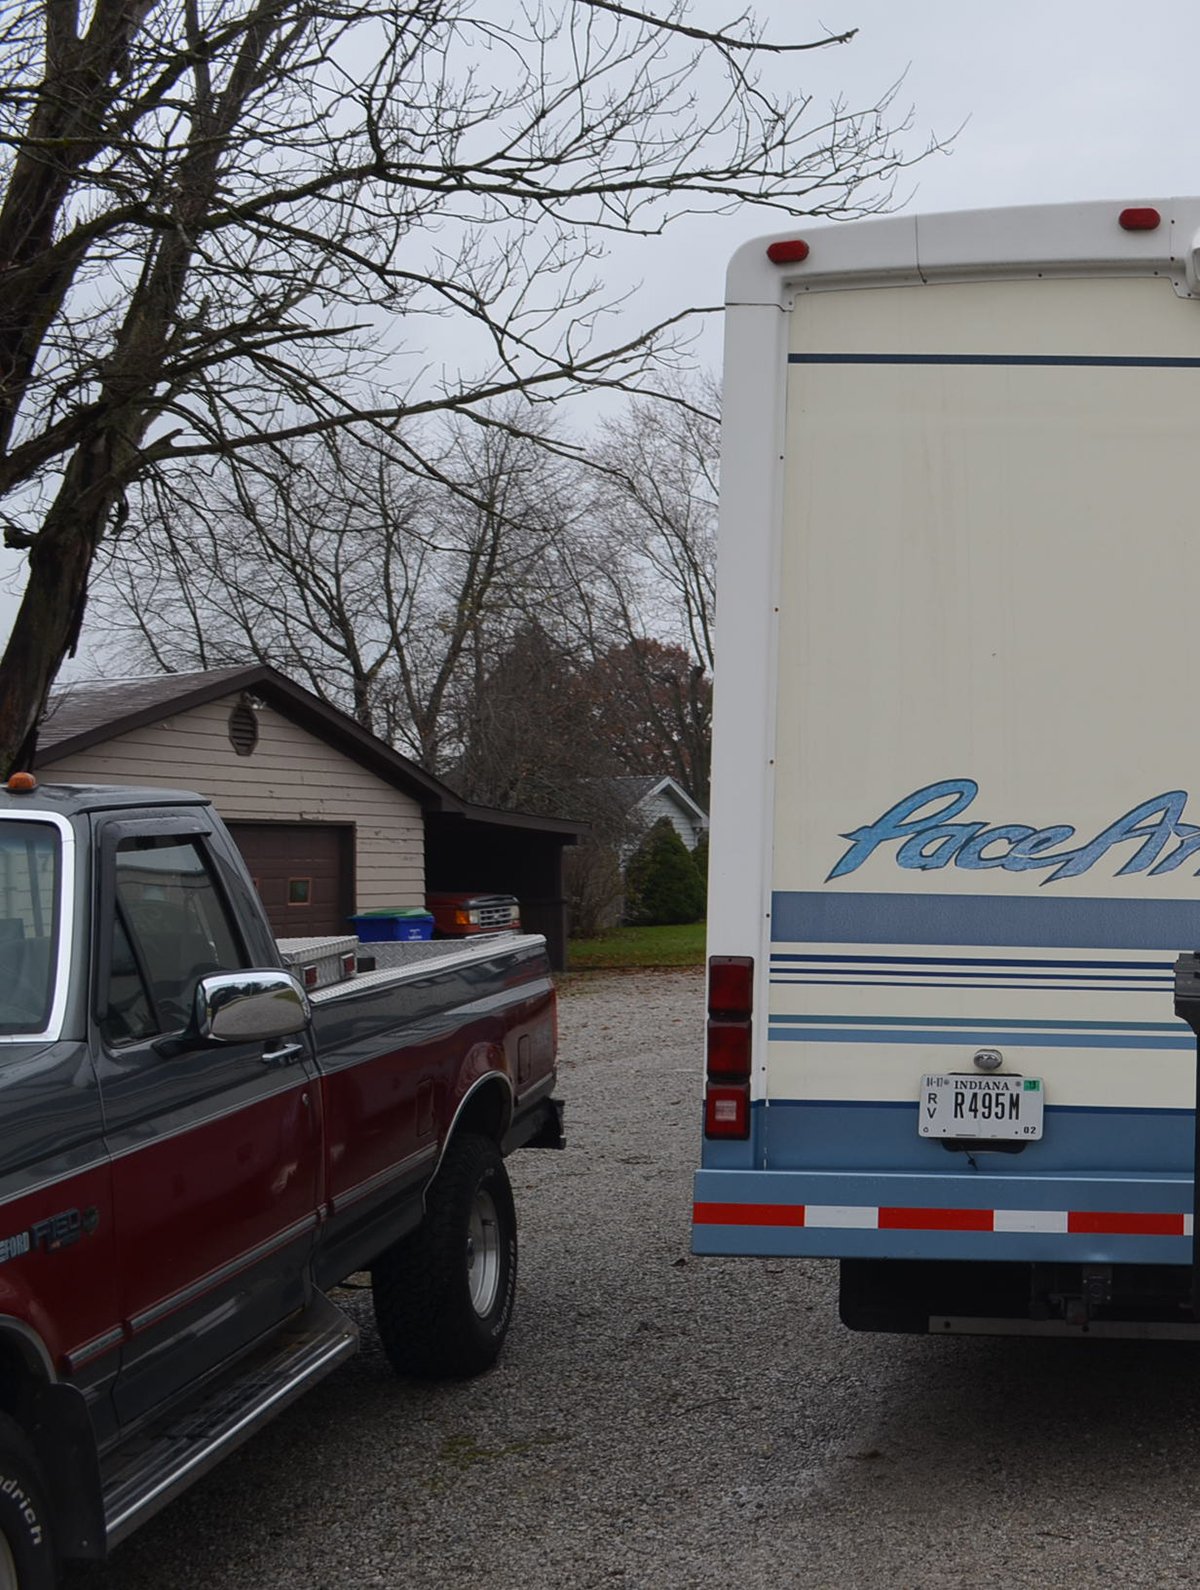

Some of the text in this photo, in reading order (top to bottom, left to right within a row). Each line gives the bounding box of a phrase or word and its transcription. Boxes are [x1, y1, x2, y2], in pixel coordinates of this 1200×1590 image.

[824, 778, 1075, 884] Pace
[954, 1080, 1010, 1092] INDIANA
[953, 1091, 1020, 1120] R495M
